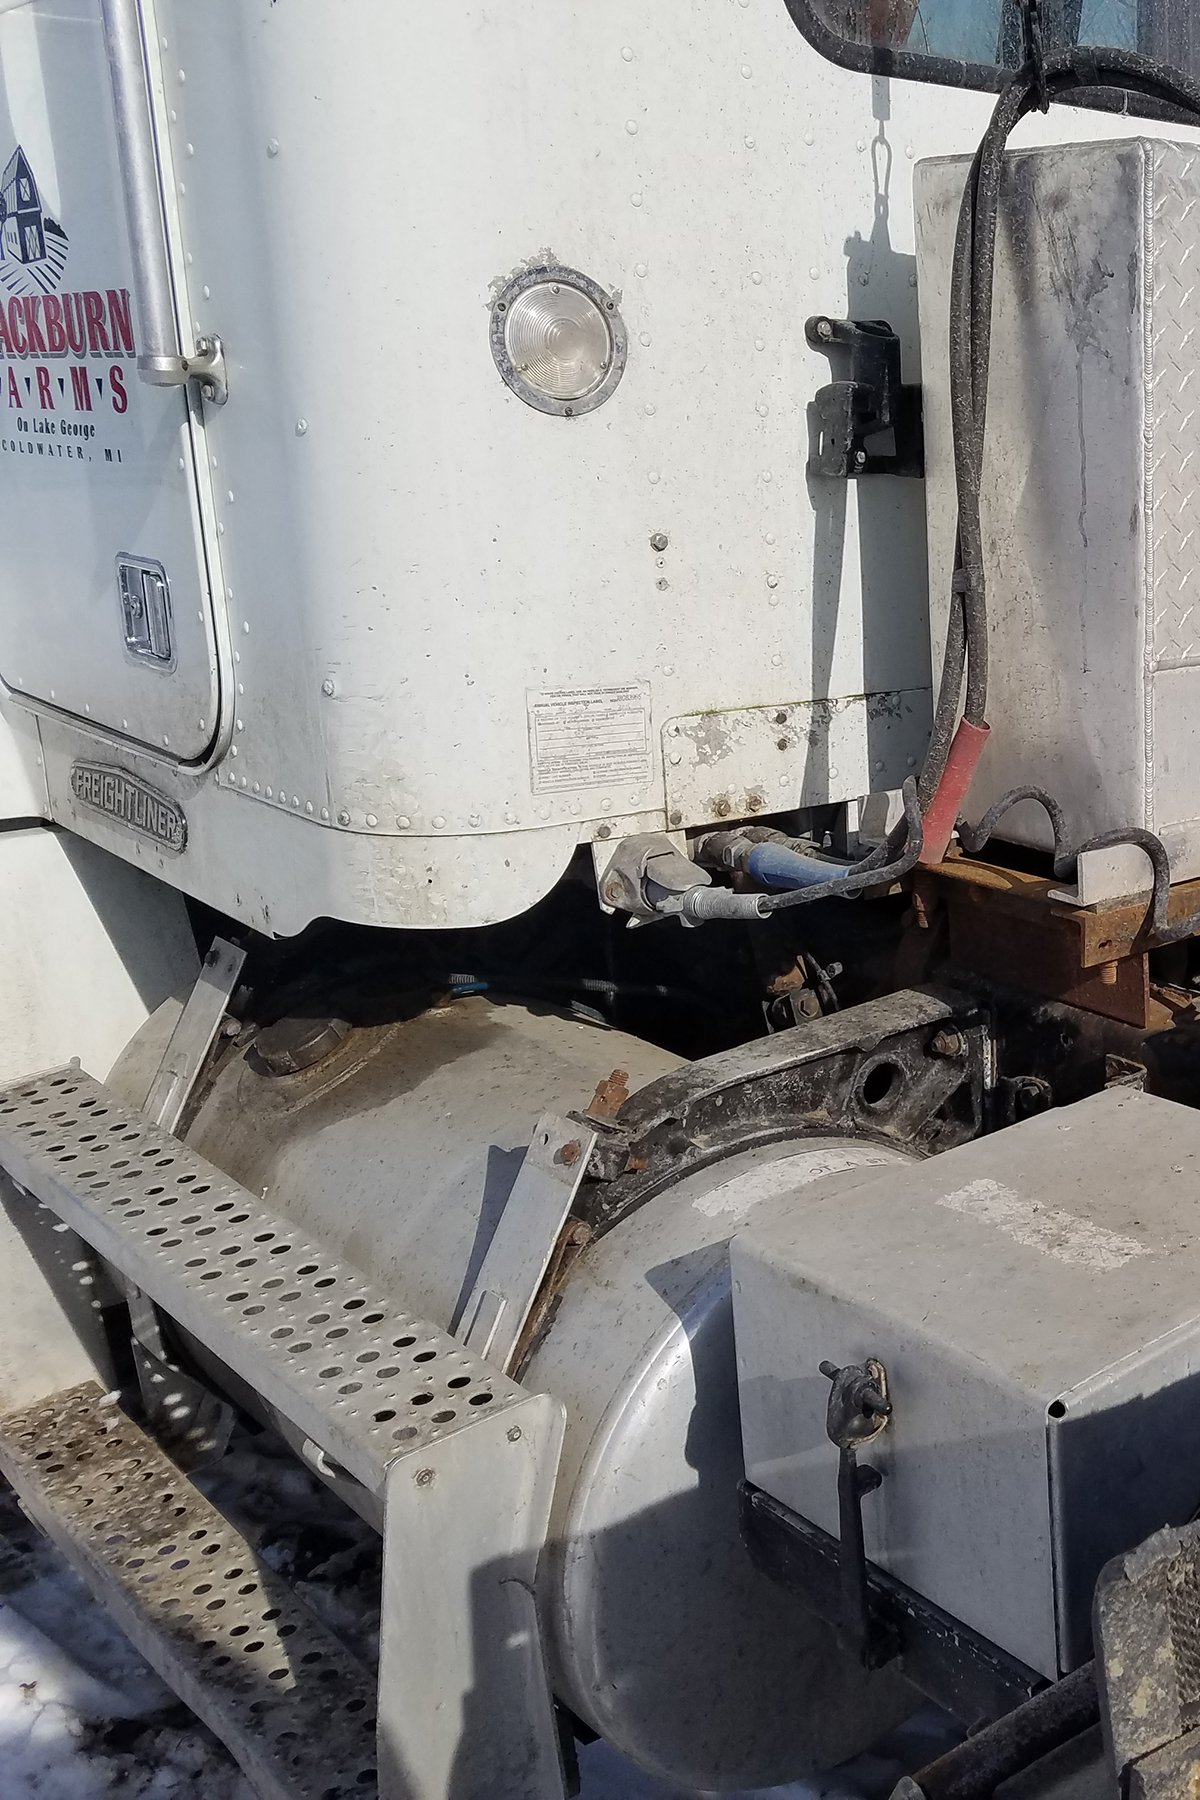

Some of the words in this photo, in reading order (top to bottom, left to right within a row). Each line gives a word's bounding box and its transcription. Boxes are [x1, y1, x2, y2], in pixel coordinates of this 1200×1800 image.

[17, 417, 28, 432] On
[33, 418, 56, 434] Lake
[60, 419, 96, 440] George
[104, 448, 122, 463] MI
[76, 767, 178, 841] FREIGHTLINER
